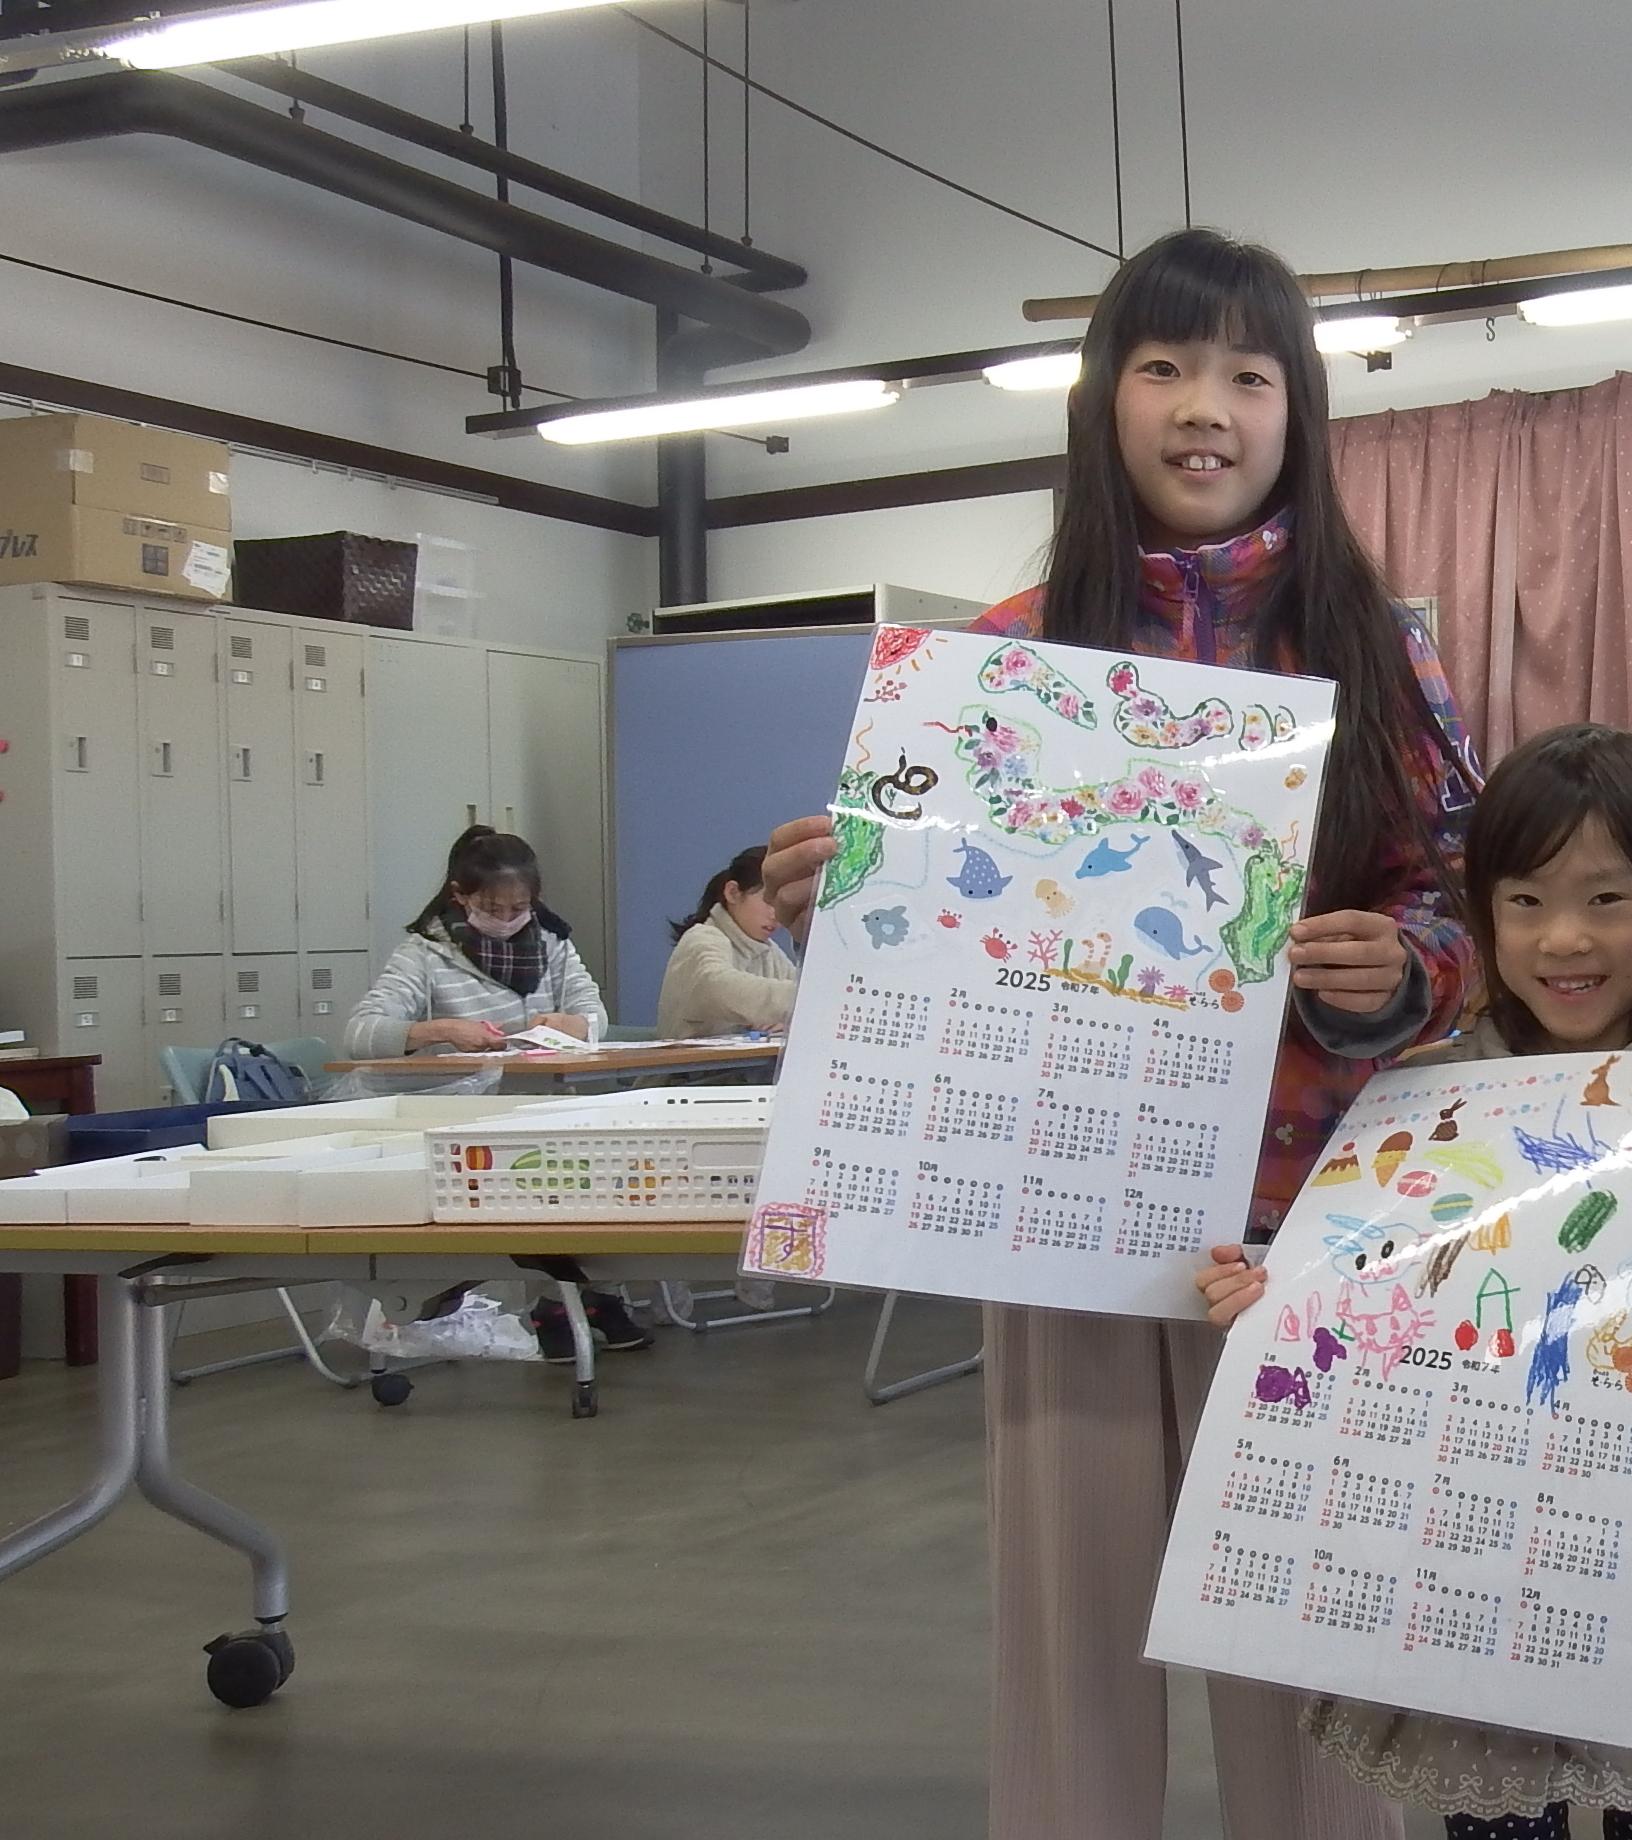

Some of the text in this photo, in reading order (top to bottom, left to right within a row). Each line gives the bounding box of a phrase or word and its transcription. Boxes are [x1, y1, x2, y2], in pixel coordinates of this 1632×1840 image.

[995, 968, 1051, 992] 2025
[764, 1217, 807, 1263] す
[1399, 1345, 1452, 1370] 2025
